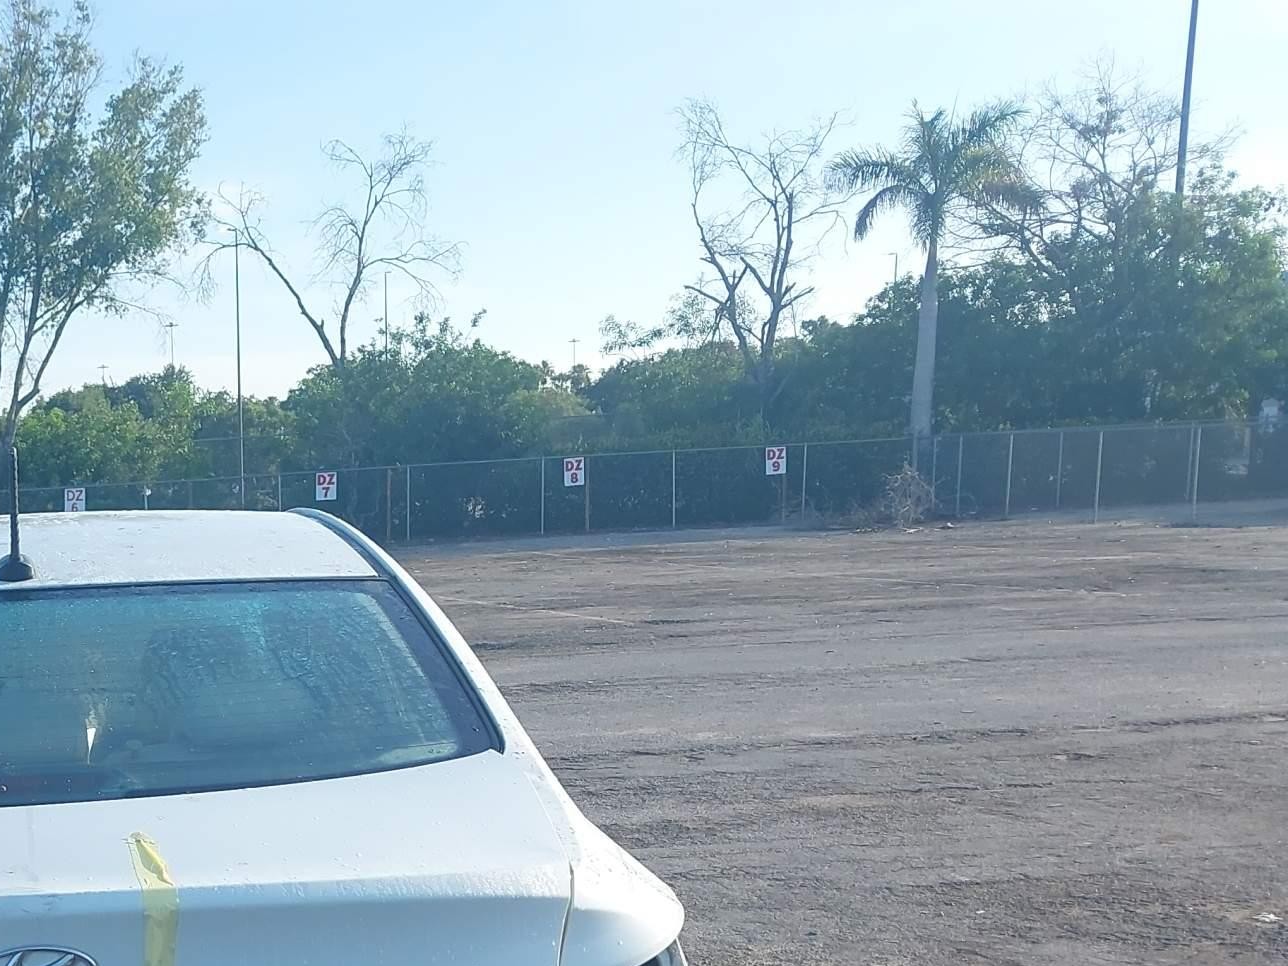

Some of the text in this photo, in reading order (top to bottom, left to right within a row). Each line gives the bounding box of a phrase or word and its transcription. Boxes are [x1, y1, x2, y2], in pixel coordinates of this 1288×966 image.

[767, 447, 785, 461] DZ
[565, 459, 583, 472] DZ
[772, 460, 781, 472] 9
[317, 473, 336, 486] DZ
[570, 472, 579, 484] 8
[66, 490, 84, 502] DZ
[322, 486, 330, 499] 7
